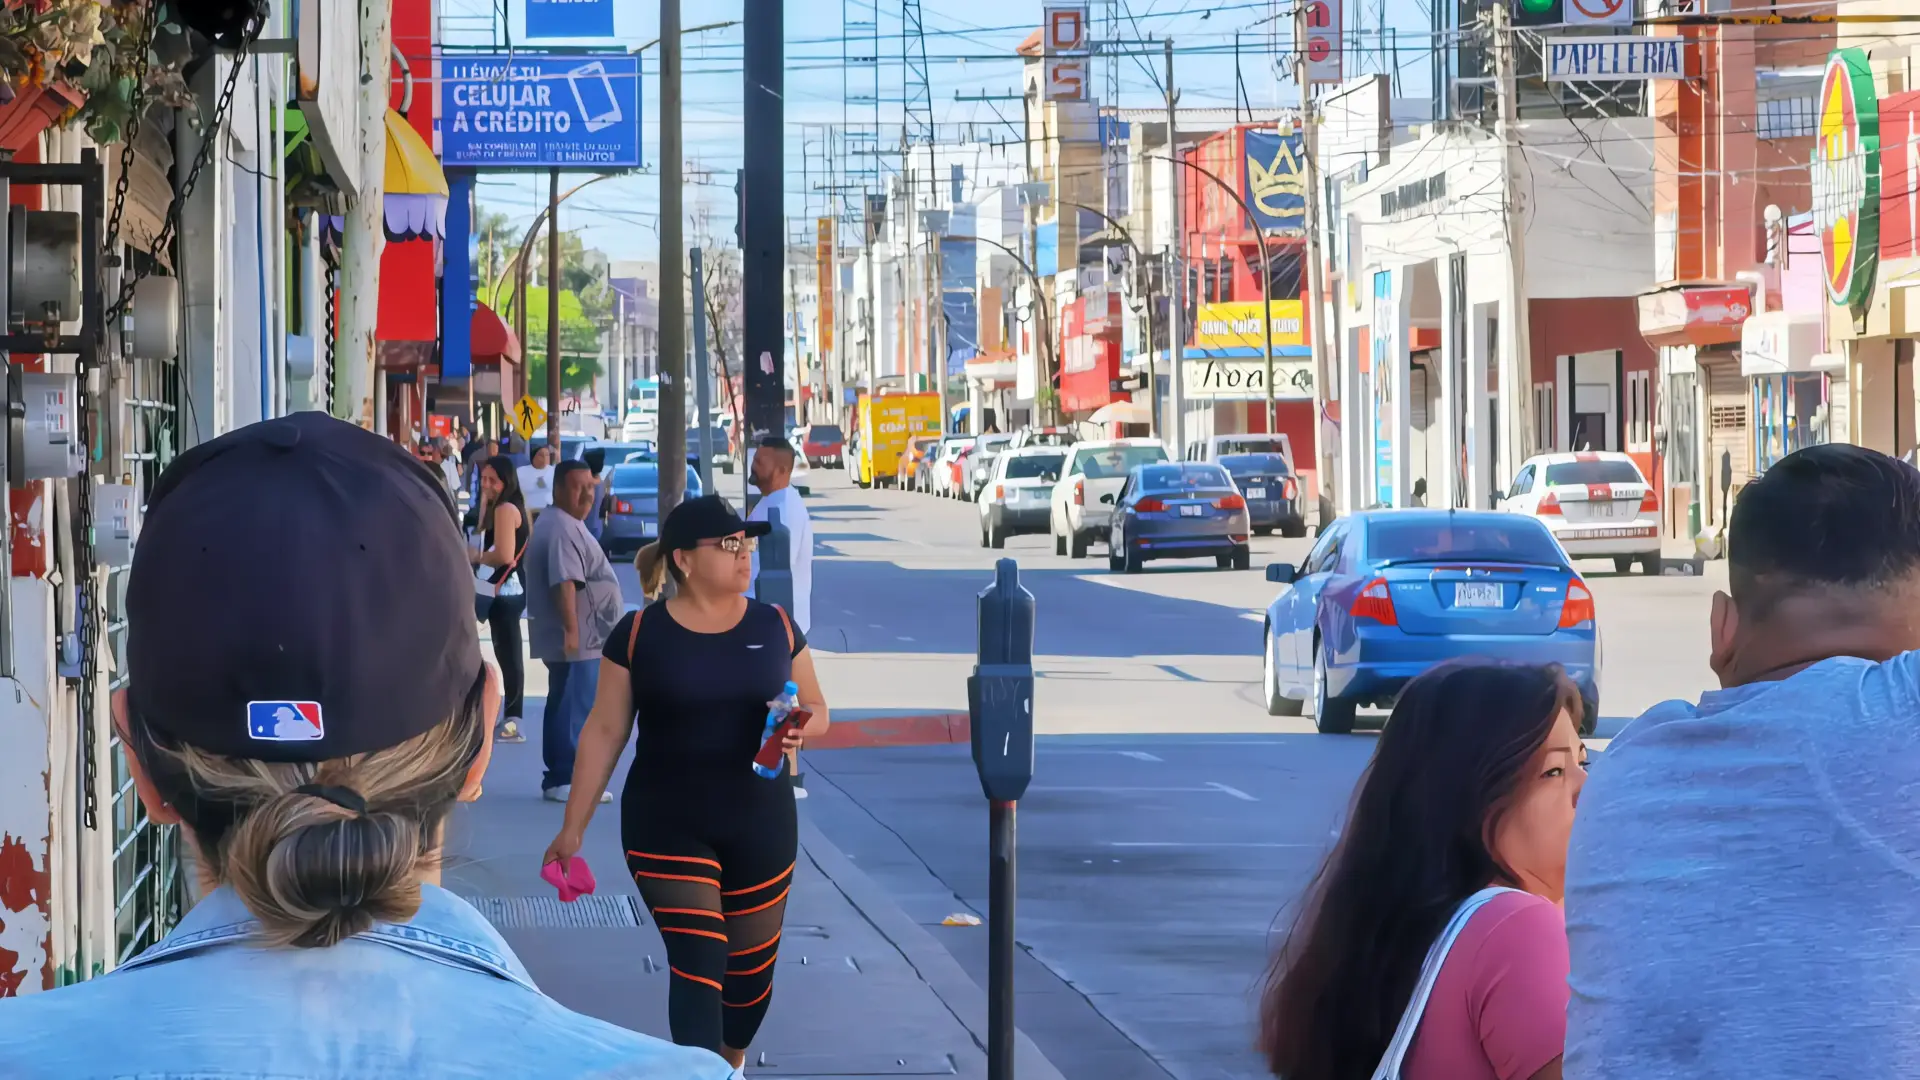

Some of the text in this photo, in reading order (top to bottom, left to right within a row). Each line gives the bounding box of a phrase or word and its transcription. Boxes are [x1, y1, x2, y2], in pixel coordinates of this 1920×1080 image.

[453, 85, 551, 107] CELULAR
[452, 106, 571, 133] A CRÉDITO
